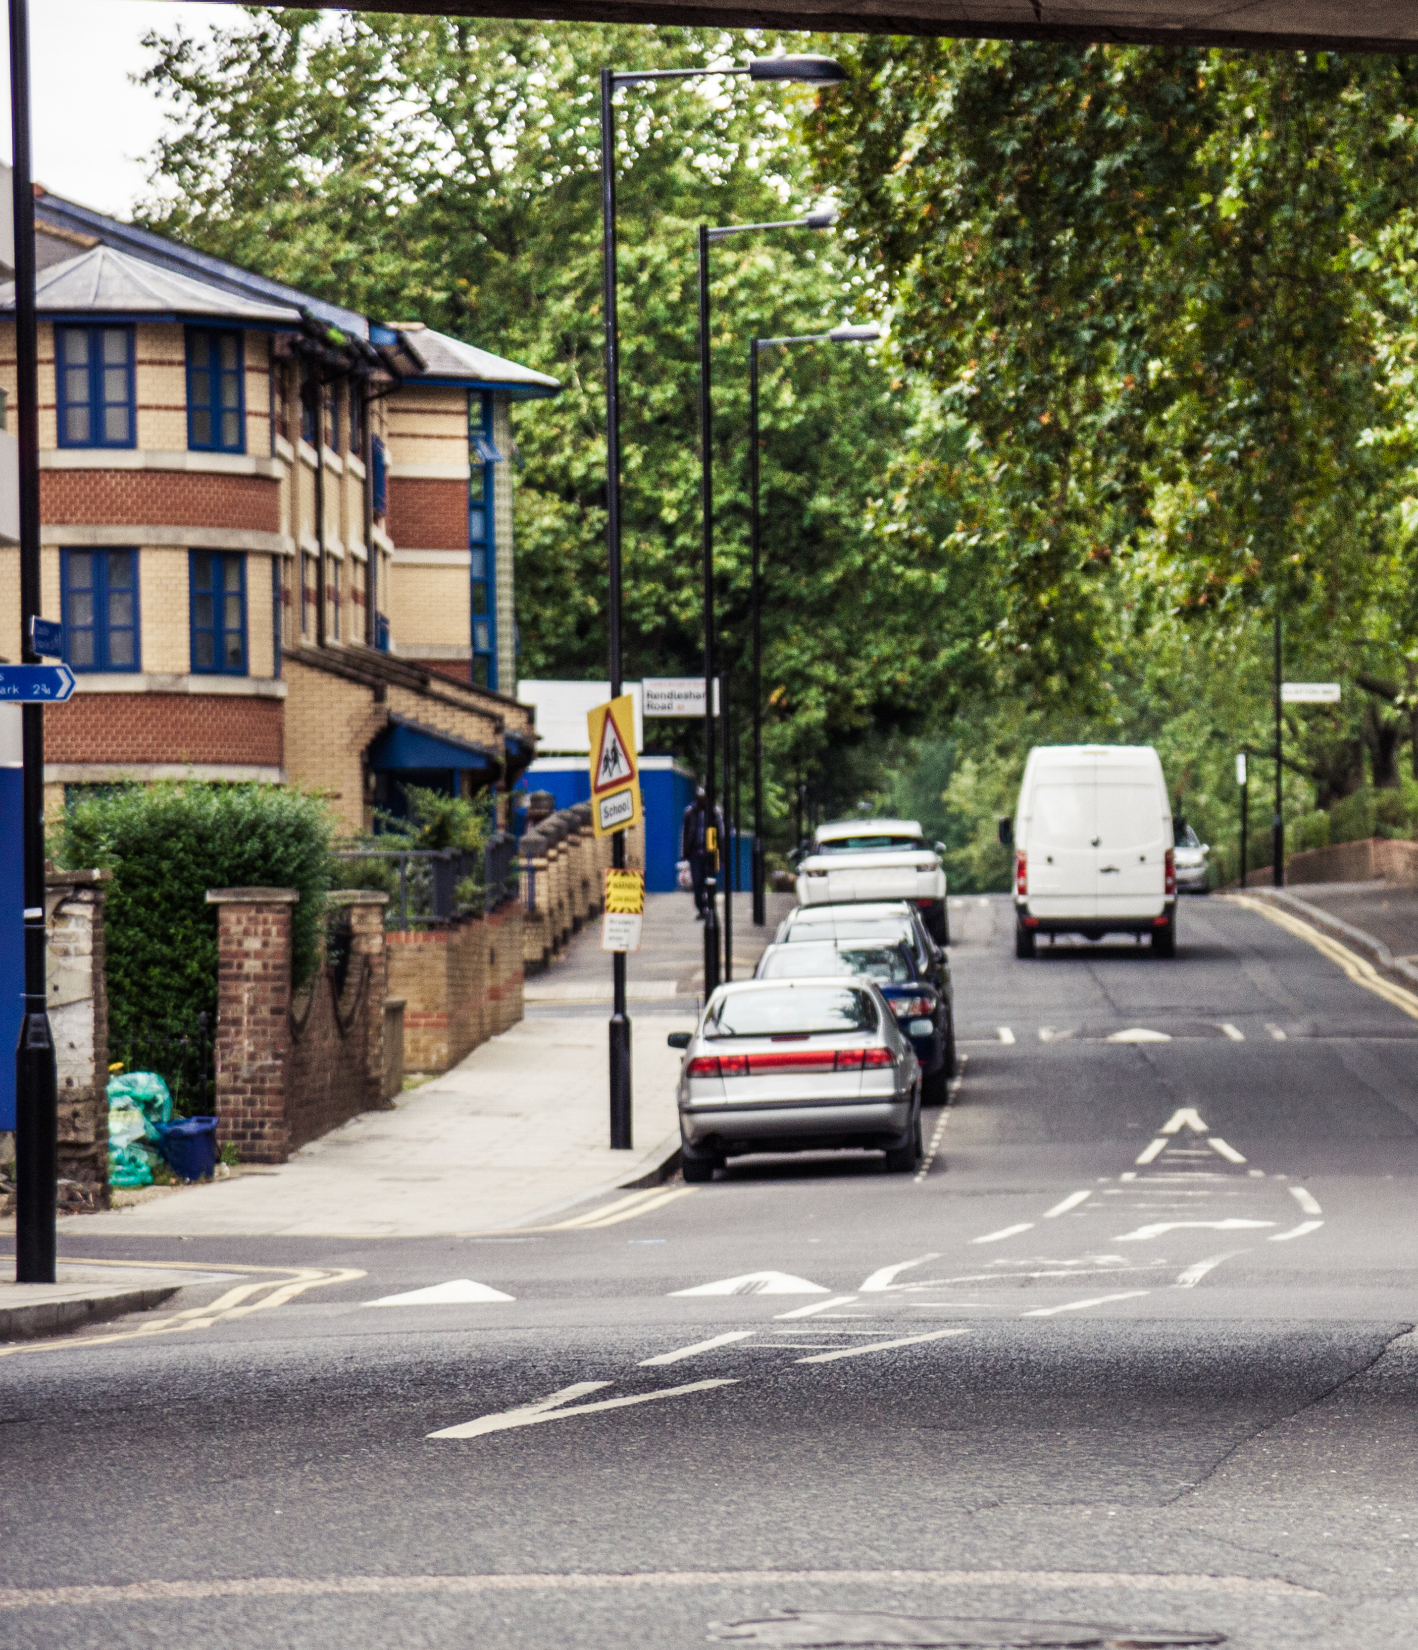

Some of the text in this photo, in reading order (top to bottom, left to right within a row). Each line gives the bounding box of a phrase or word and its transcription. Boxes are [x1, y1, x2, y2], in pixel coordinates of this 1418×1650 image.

[0, 684, 20, 695] ark
[646, 701, 673, 710] Road
[604, 798, 630, 819] School
